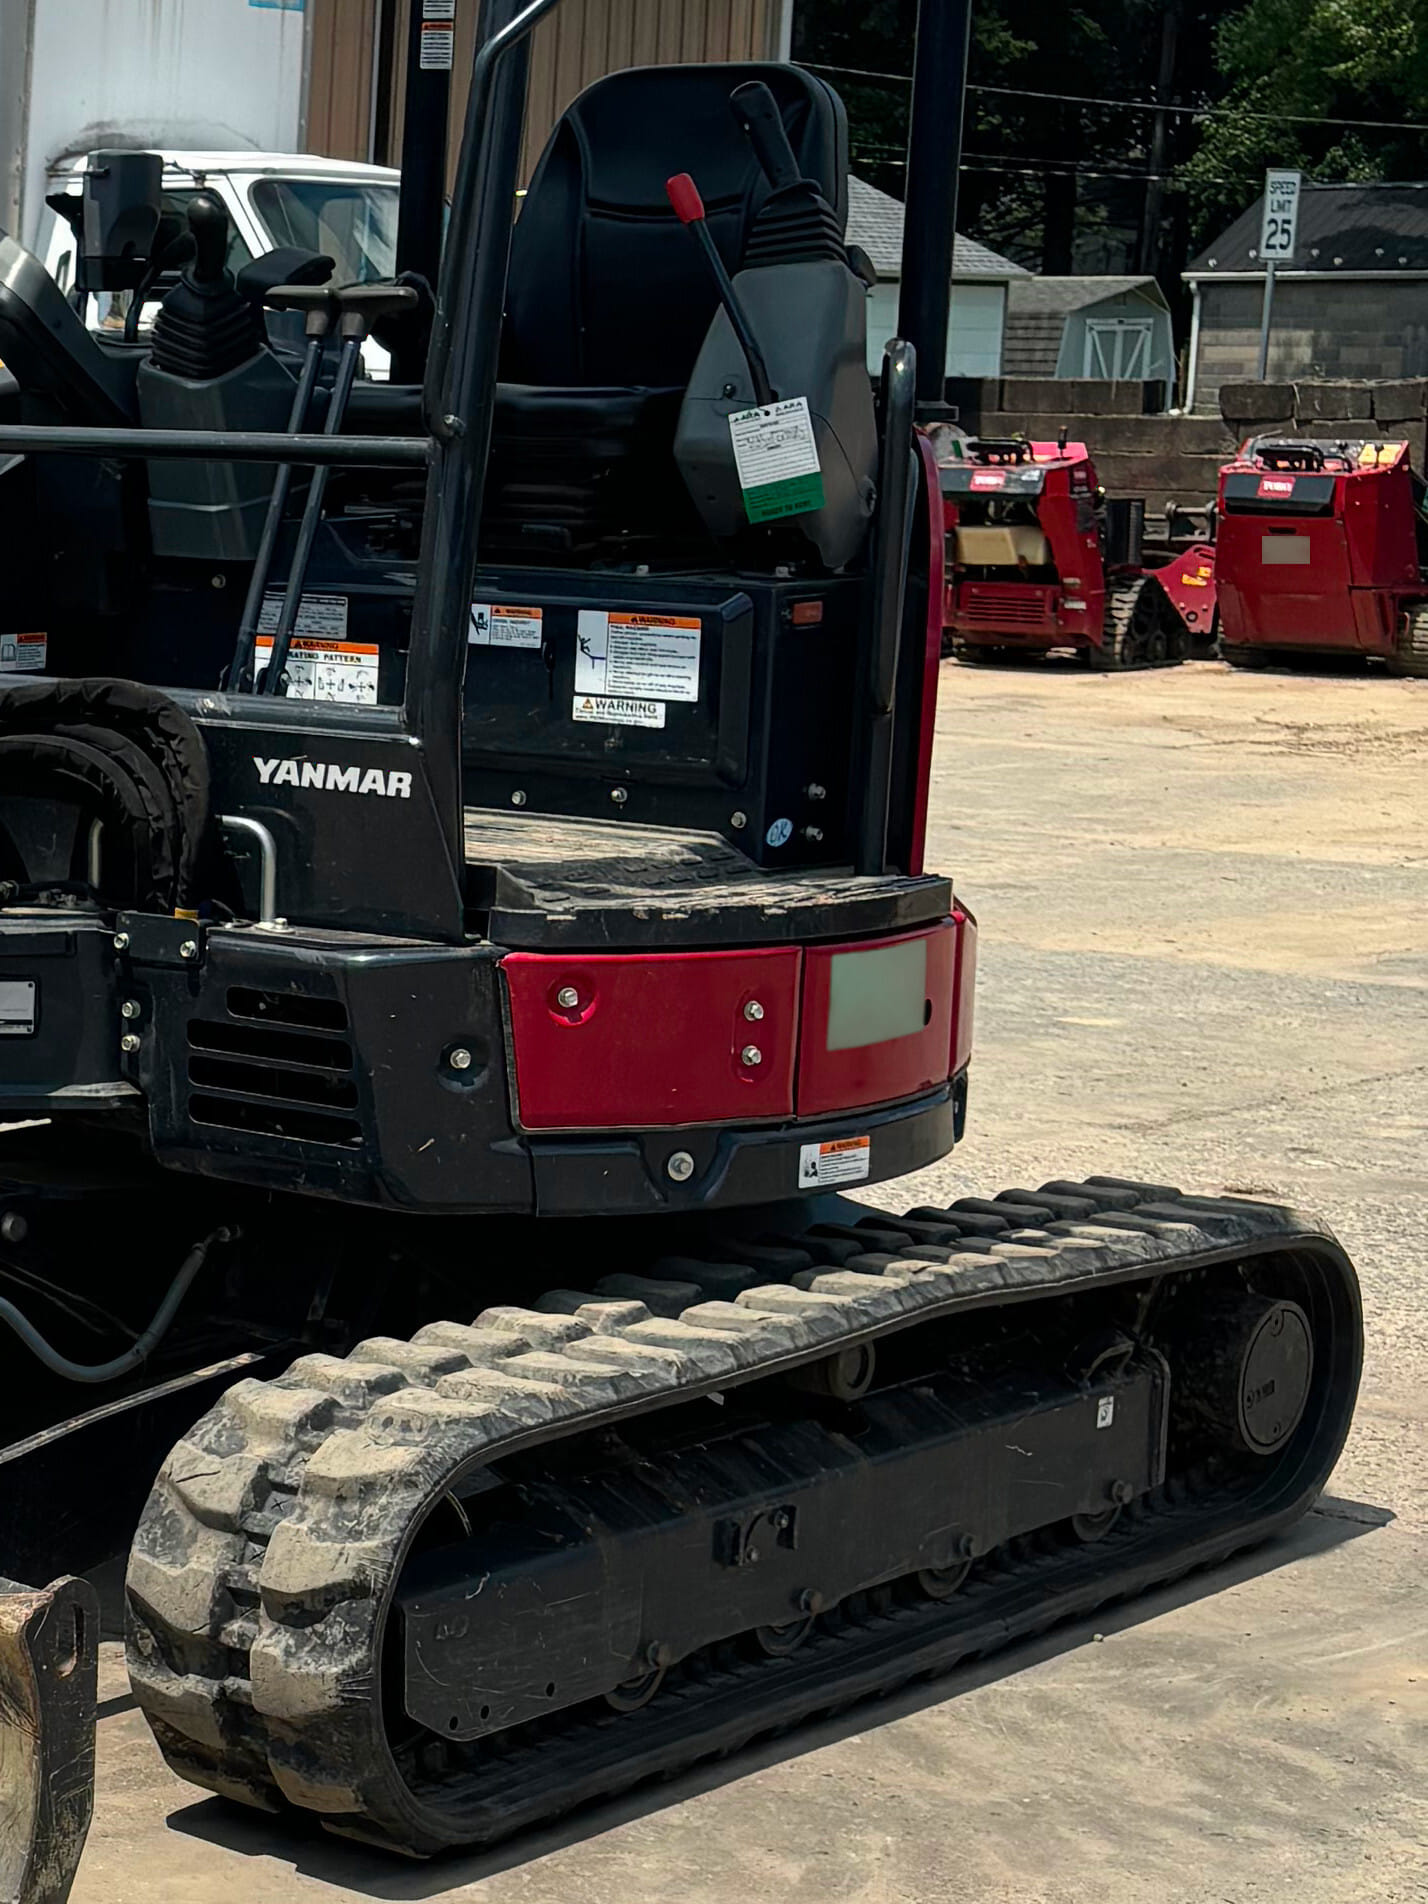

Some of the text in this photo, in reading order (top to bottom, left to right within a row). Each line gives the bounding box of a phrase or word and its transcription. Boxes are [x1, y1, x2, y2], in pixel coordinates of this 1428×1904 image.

[1269, 180, 1296, 195] SPEED
[1265, 218, 1292, 250] 25
[594, 698, 657, 714] WARNING
[253, 756, 412, 798] YANMAR
